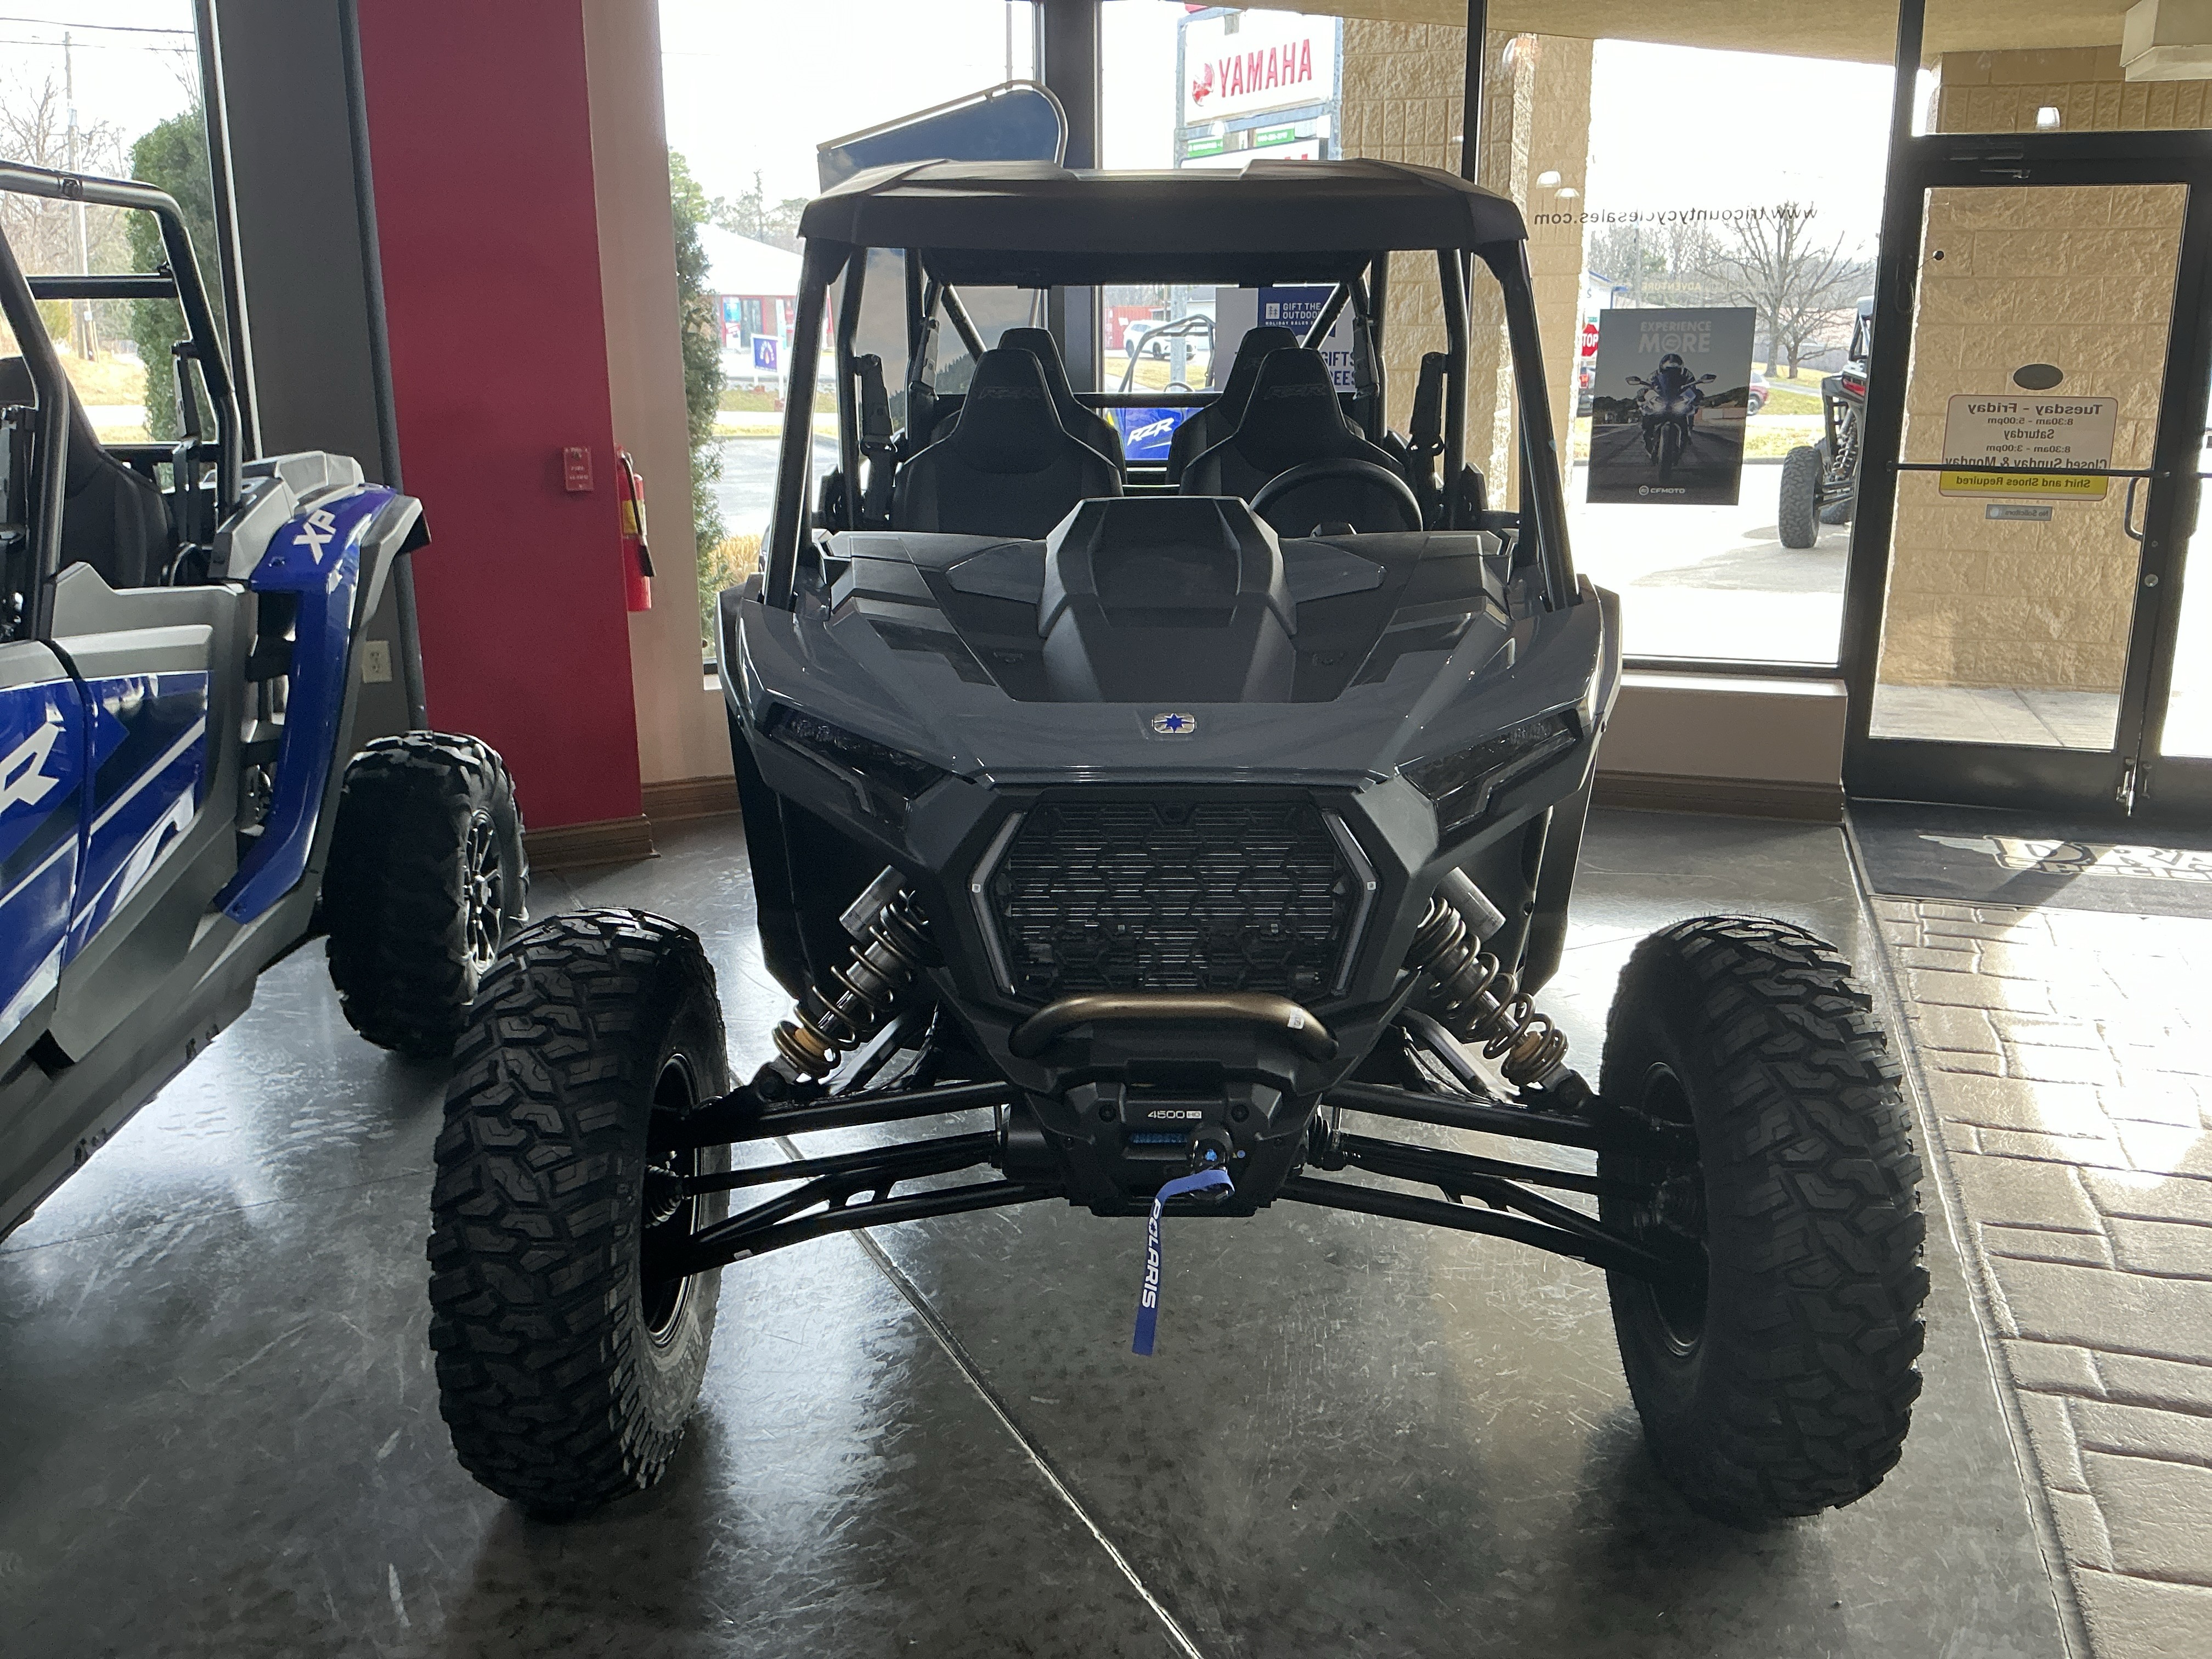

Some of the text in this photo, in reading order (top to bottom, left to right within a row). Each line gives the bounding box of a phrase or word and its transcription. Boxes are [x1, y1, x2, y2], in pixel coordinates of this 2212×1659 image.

[1219, 38, 1312, 98] YAMAHA
[1283, 302, 1321, 311] GIFT THE
[1282, 311, 1320, 319] OUTDOO
[1640, 320, 1712, 332] EXPERIENCE
[1582, 333, 1599, 348] TOP
[1638, 332, 1712, 354] MORE
[1330, 370, 1355, 386] EE
[1127, 417, 1175, 447] RZR
[293, 509, 336, 565] XP
[1147, 1110, 1186, 1119] 4500
[1142, 1197, 1163, 1309] POLARIS
